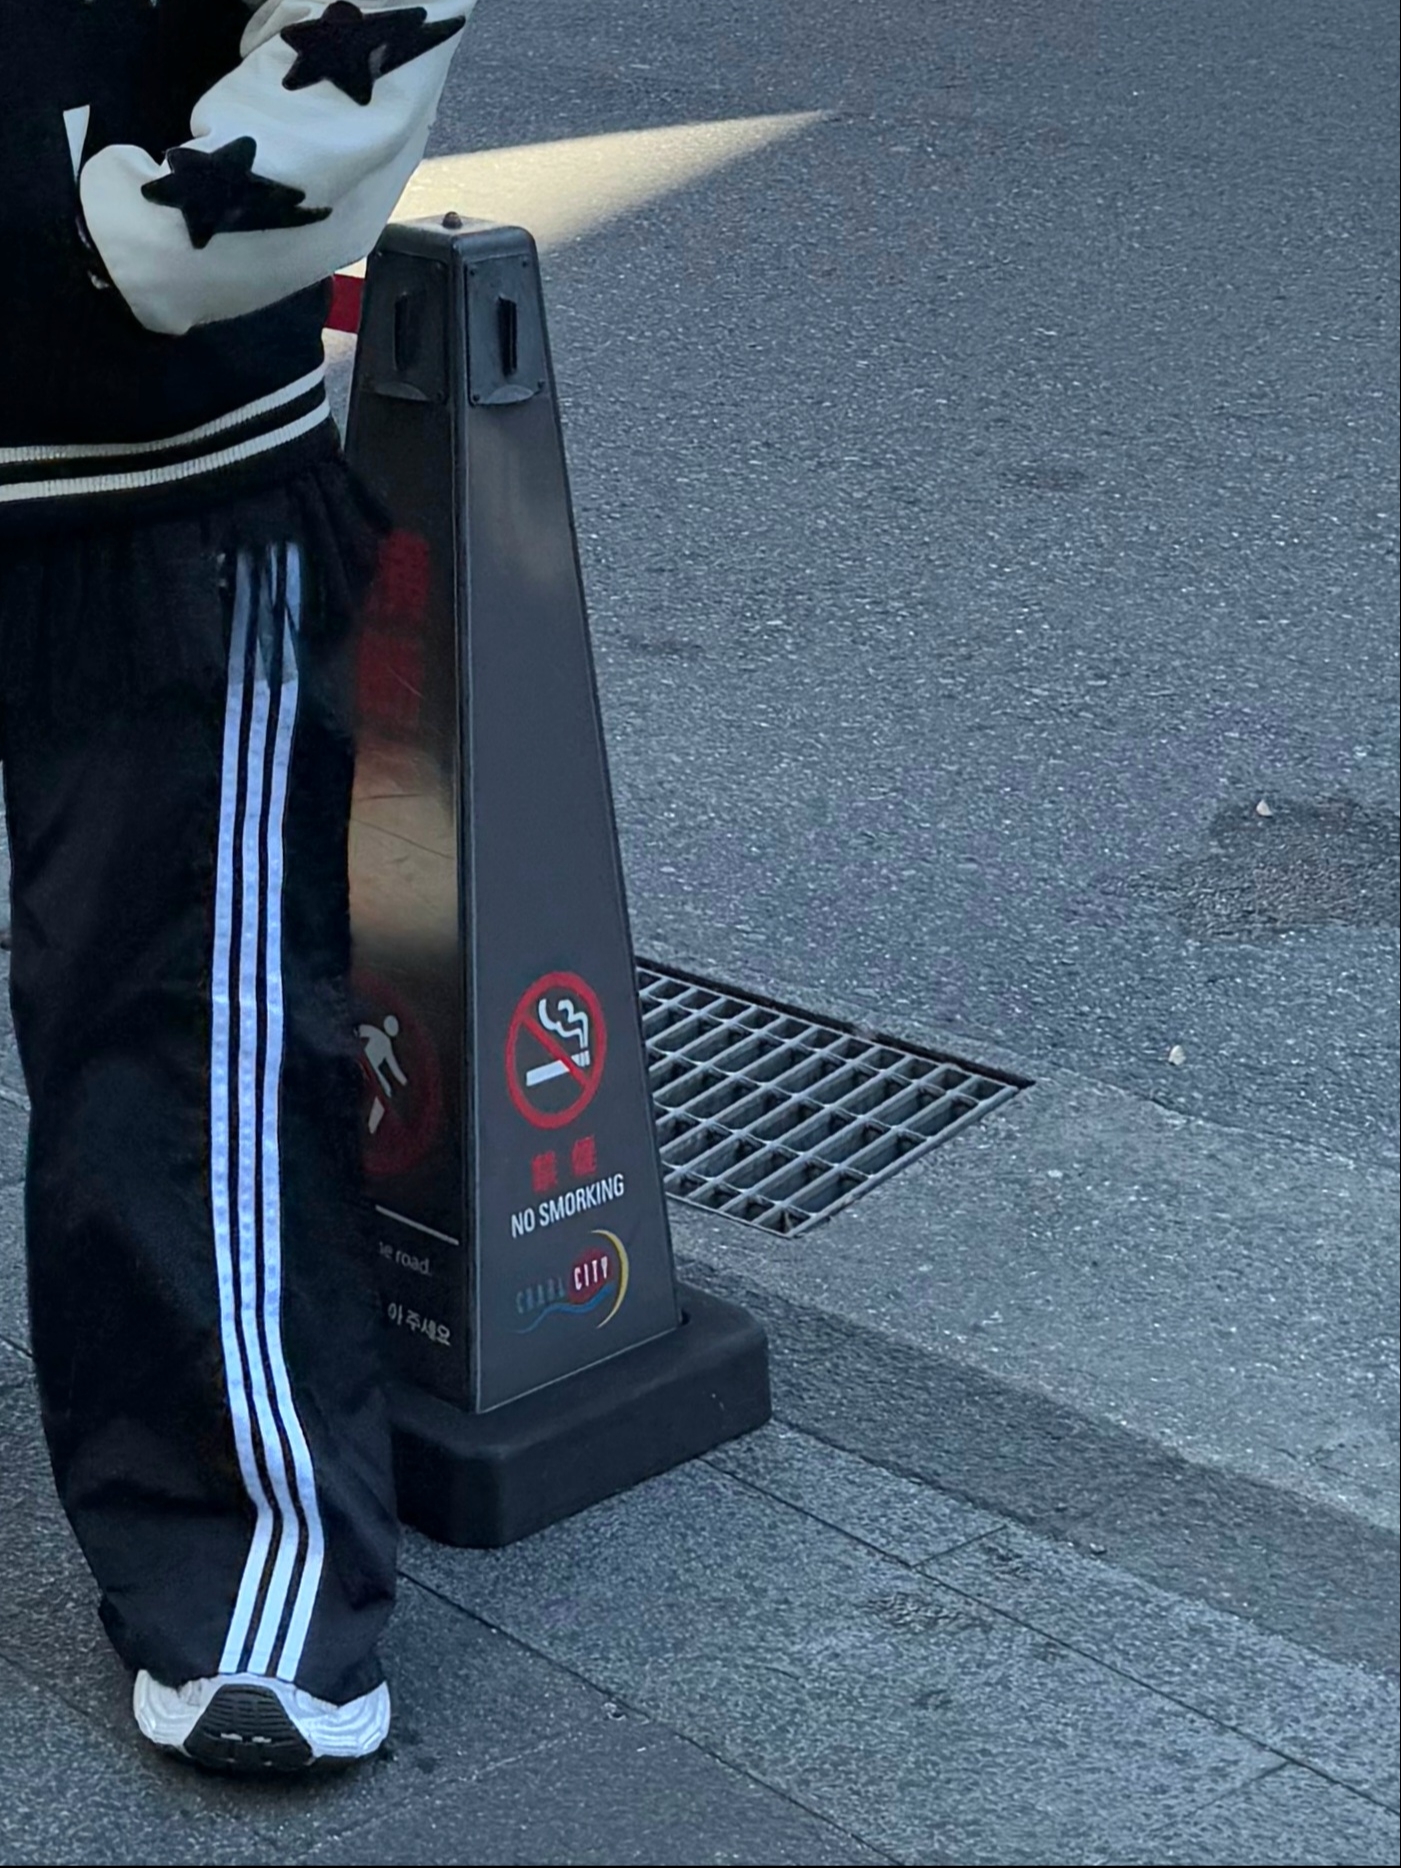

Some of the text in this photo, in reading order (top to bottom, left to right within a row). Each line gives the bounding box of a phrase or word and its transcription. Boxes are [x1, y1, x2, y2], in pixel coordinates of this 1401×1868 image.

[511, 1173, 625, 1239] NO SMORKING
[574, 1255, 609, 1291] CITY
